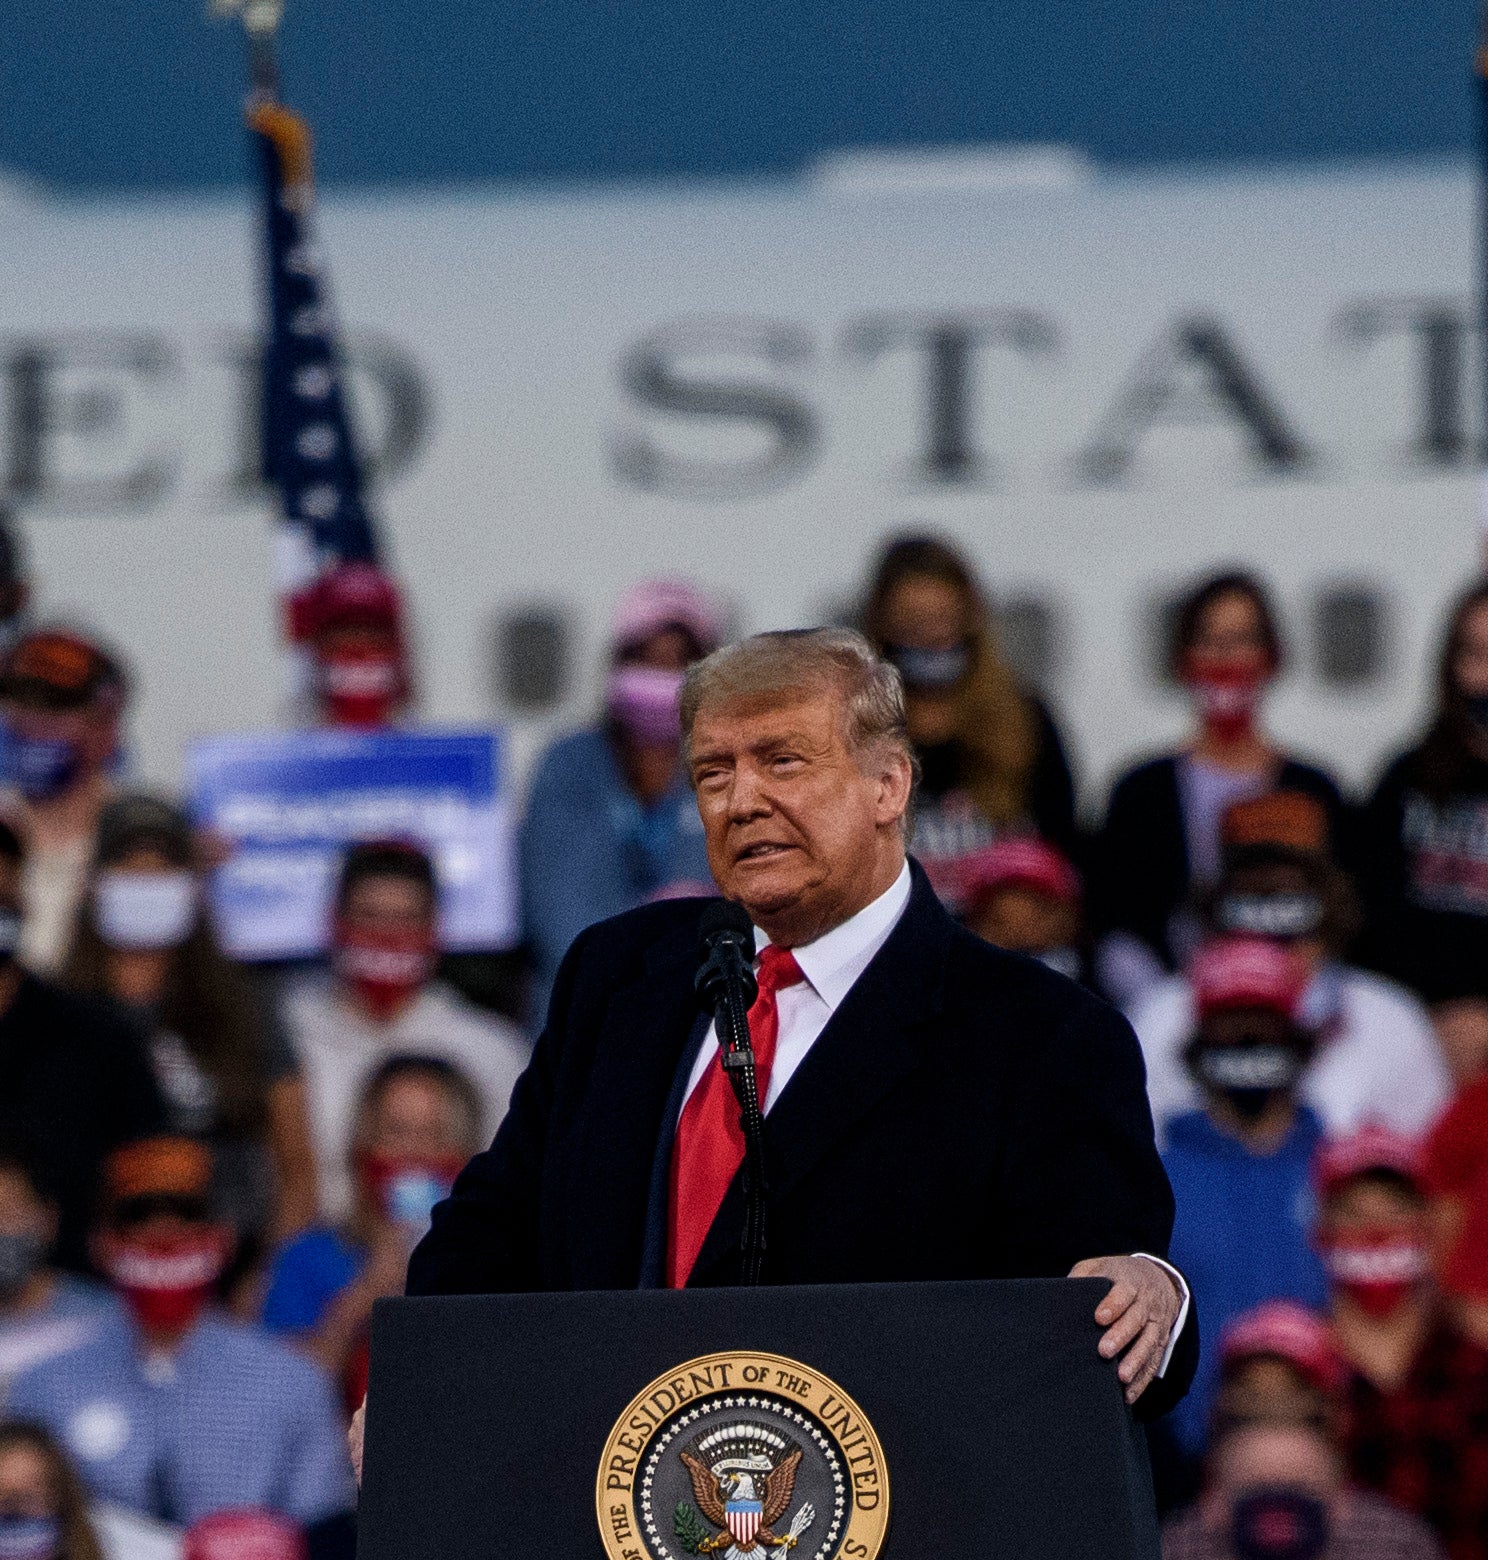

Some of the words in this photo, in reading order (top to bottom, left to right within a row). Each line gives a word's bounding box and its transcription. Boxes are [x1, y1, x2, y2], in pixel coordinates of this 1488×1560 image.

[742, 1365, 770, 1383] OF
[776, 1370, 812, 1398] THE
[606, 1363, 734, 1492] PRESIDENT
[819, 1394, 880, 1511] UNITED
[610, 1503, 632, 1545] THE
